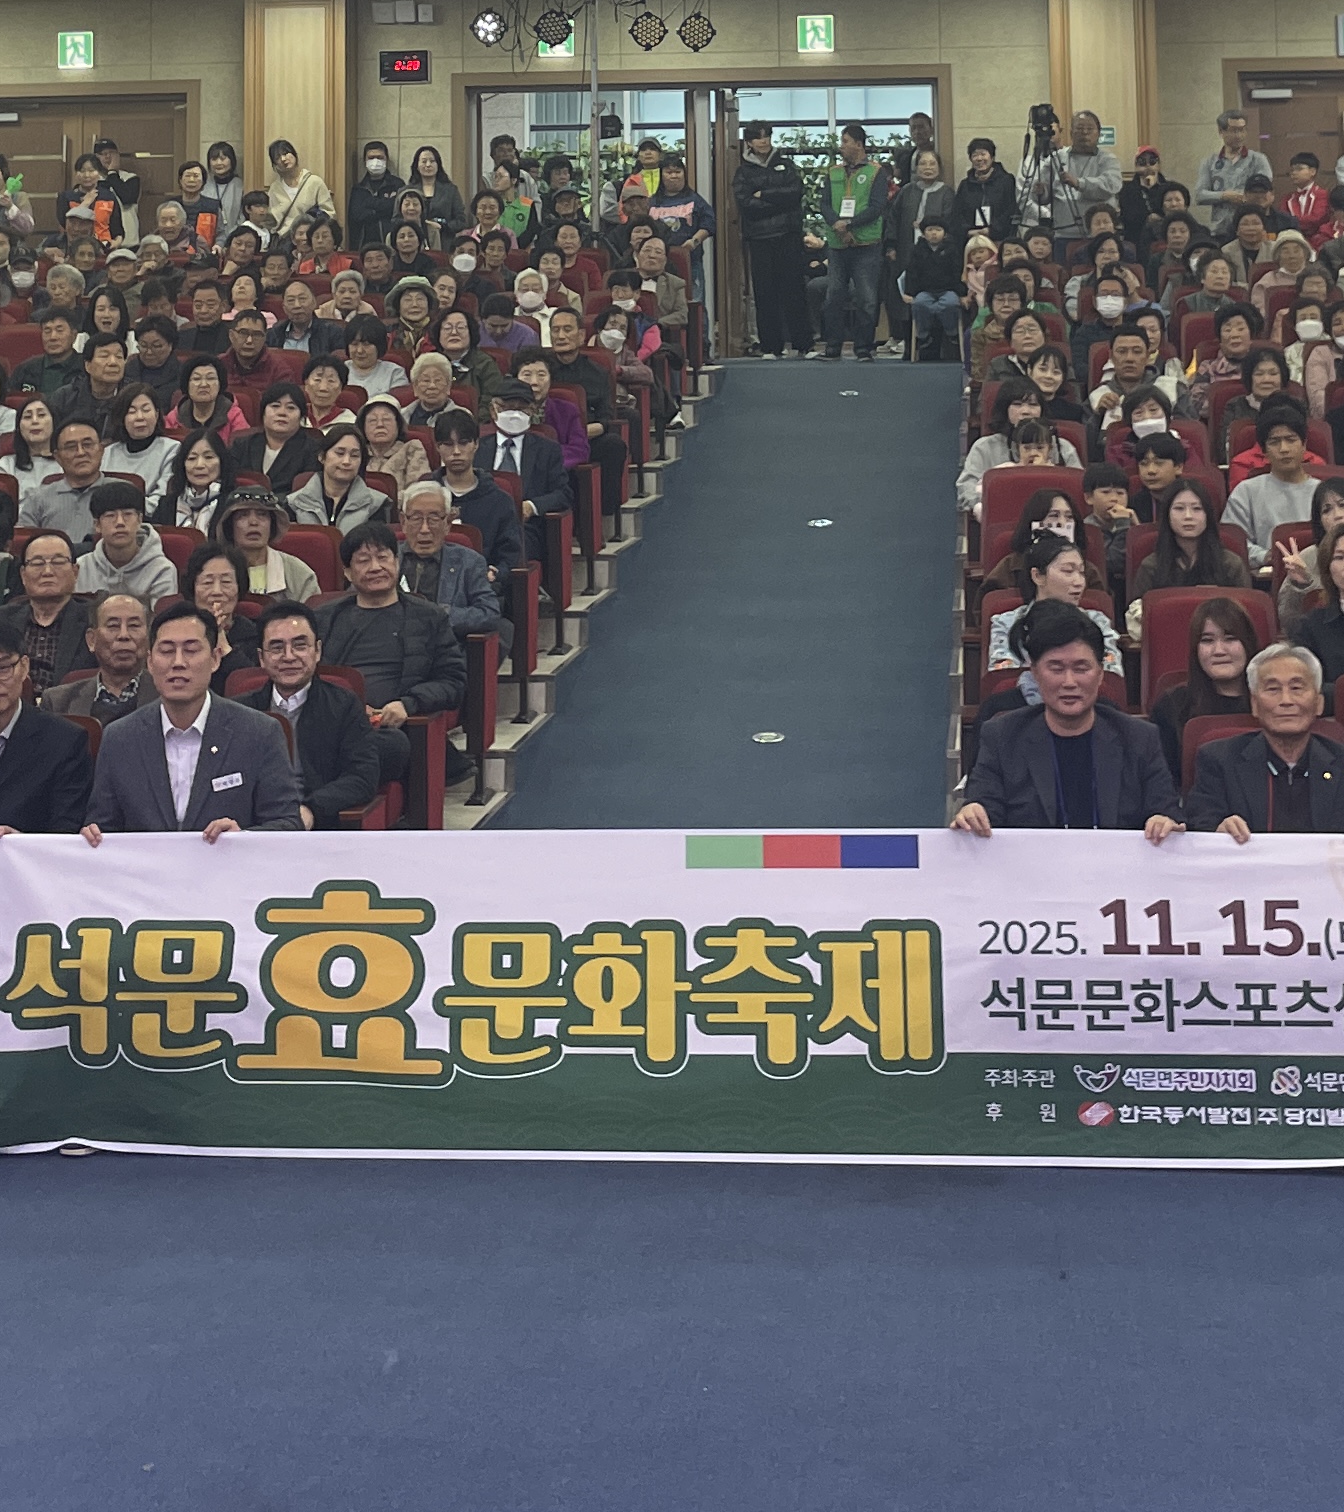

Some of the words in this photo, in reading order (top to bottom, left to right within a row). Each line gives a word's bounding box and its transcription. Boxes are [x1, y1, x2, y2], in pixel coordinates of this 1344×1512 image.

[978, 920, 1087, 956] 2025.
[1099, 899, 1201, 957] 11.
[1122, 1068, 1256, 1092] 석문면주민자치회
